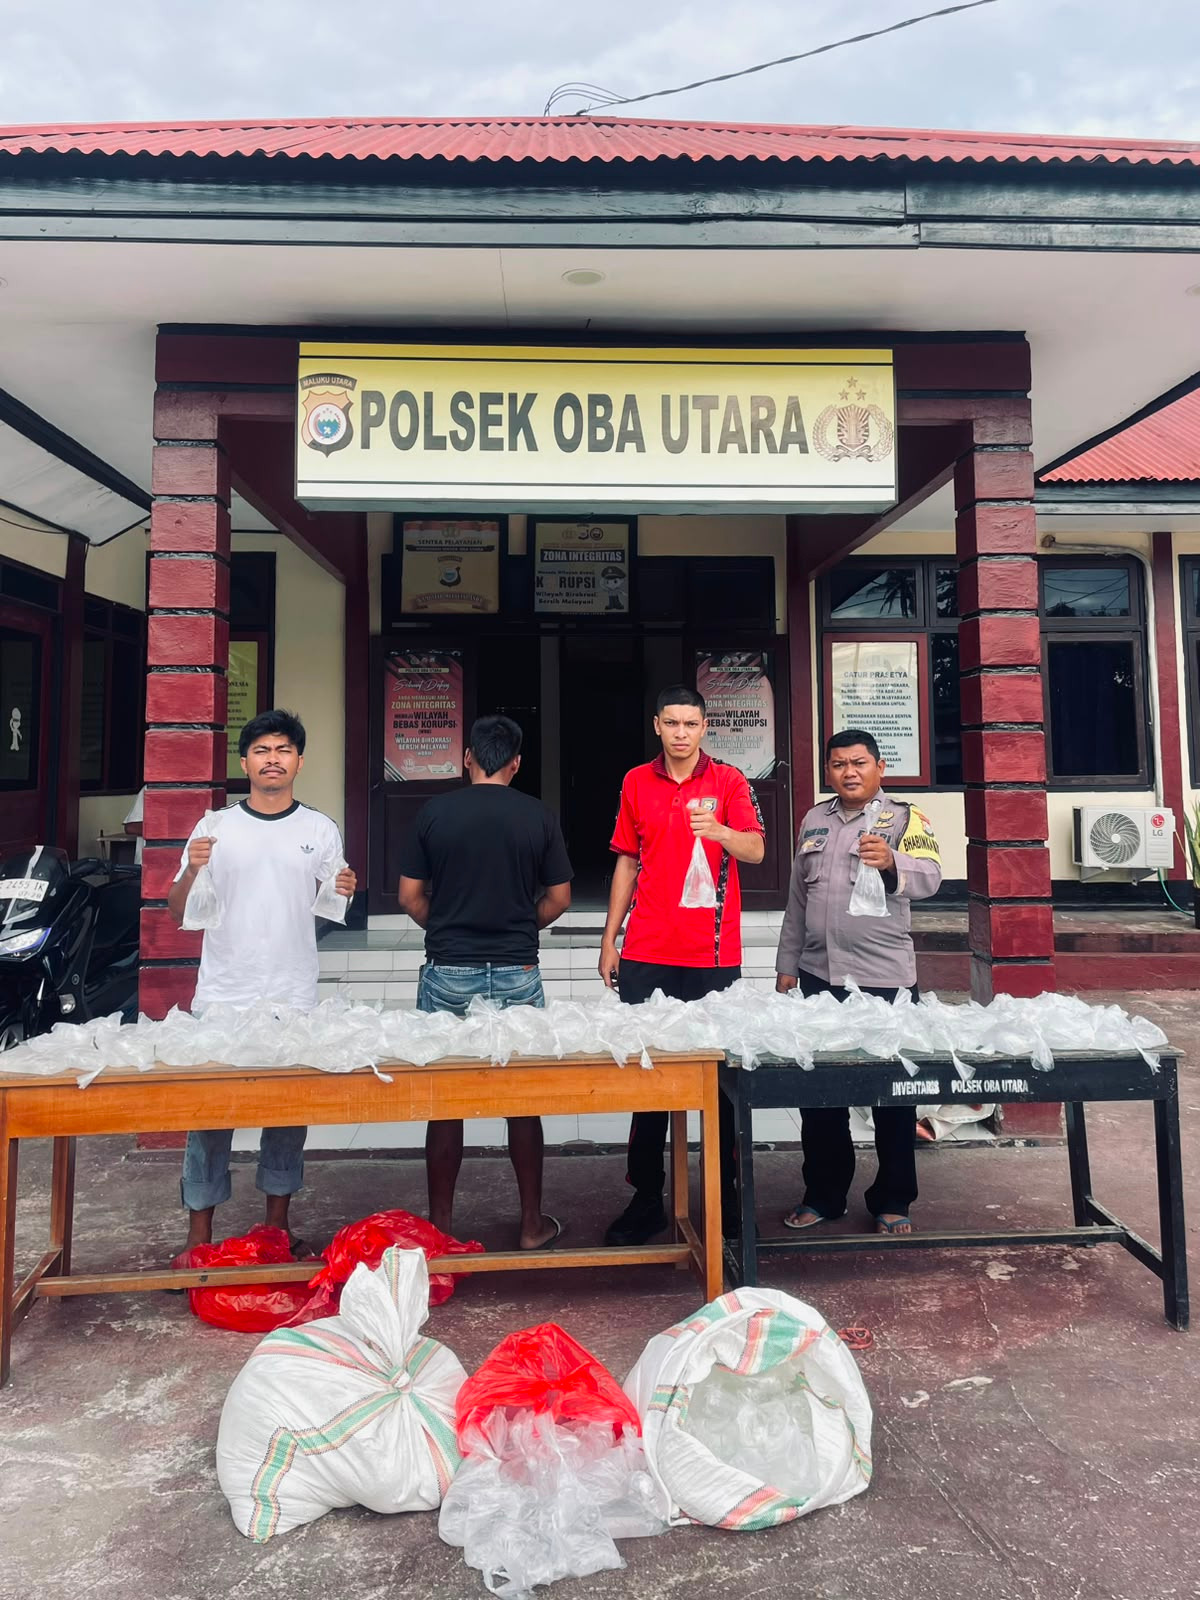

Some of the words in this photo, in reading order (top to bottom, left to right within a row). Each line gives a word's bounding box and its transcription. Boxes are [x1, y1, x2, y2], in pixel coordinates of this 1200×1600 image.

[303, 377, 330, 387] MALUKU
[331, 377, 353, 388] UTARA
[361, 390, 539, 452] POLSEK
[553, 392, 646, 454] OBA
[661, 394, 810, 455] UTARA
[543, 551, 567, 561] ZONA
[569, 551, 622, 561] INTEGRITAS
[391, 701, 411, 709] ZONA
[413, 701, 457, 709] INTEGRITAS
[724, 700, 768, 708] INTEGRITAS
[413, 711, 449, 719] WILAYAH
[725, 710, 760, 718] WILAYAH
[393, 720, 419, 728] BEBAS
[420, 720, 456, 728] KORUPSI
[732, 719, 768, 727] KORUPSI
[892, 1080, 940, 1096] INVENTARIS
[951, 1079, 982, 1093] POLSEK
[983, 1079, 1000, 1093] OBA
[1001, 1079, 1029, 1093] UTARA
